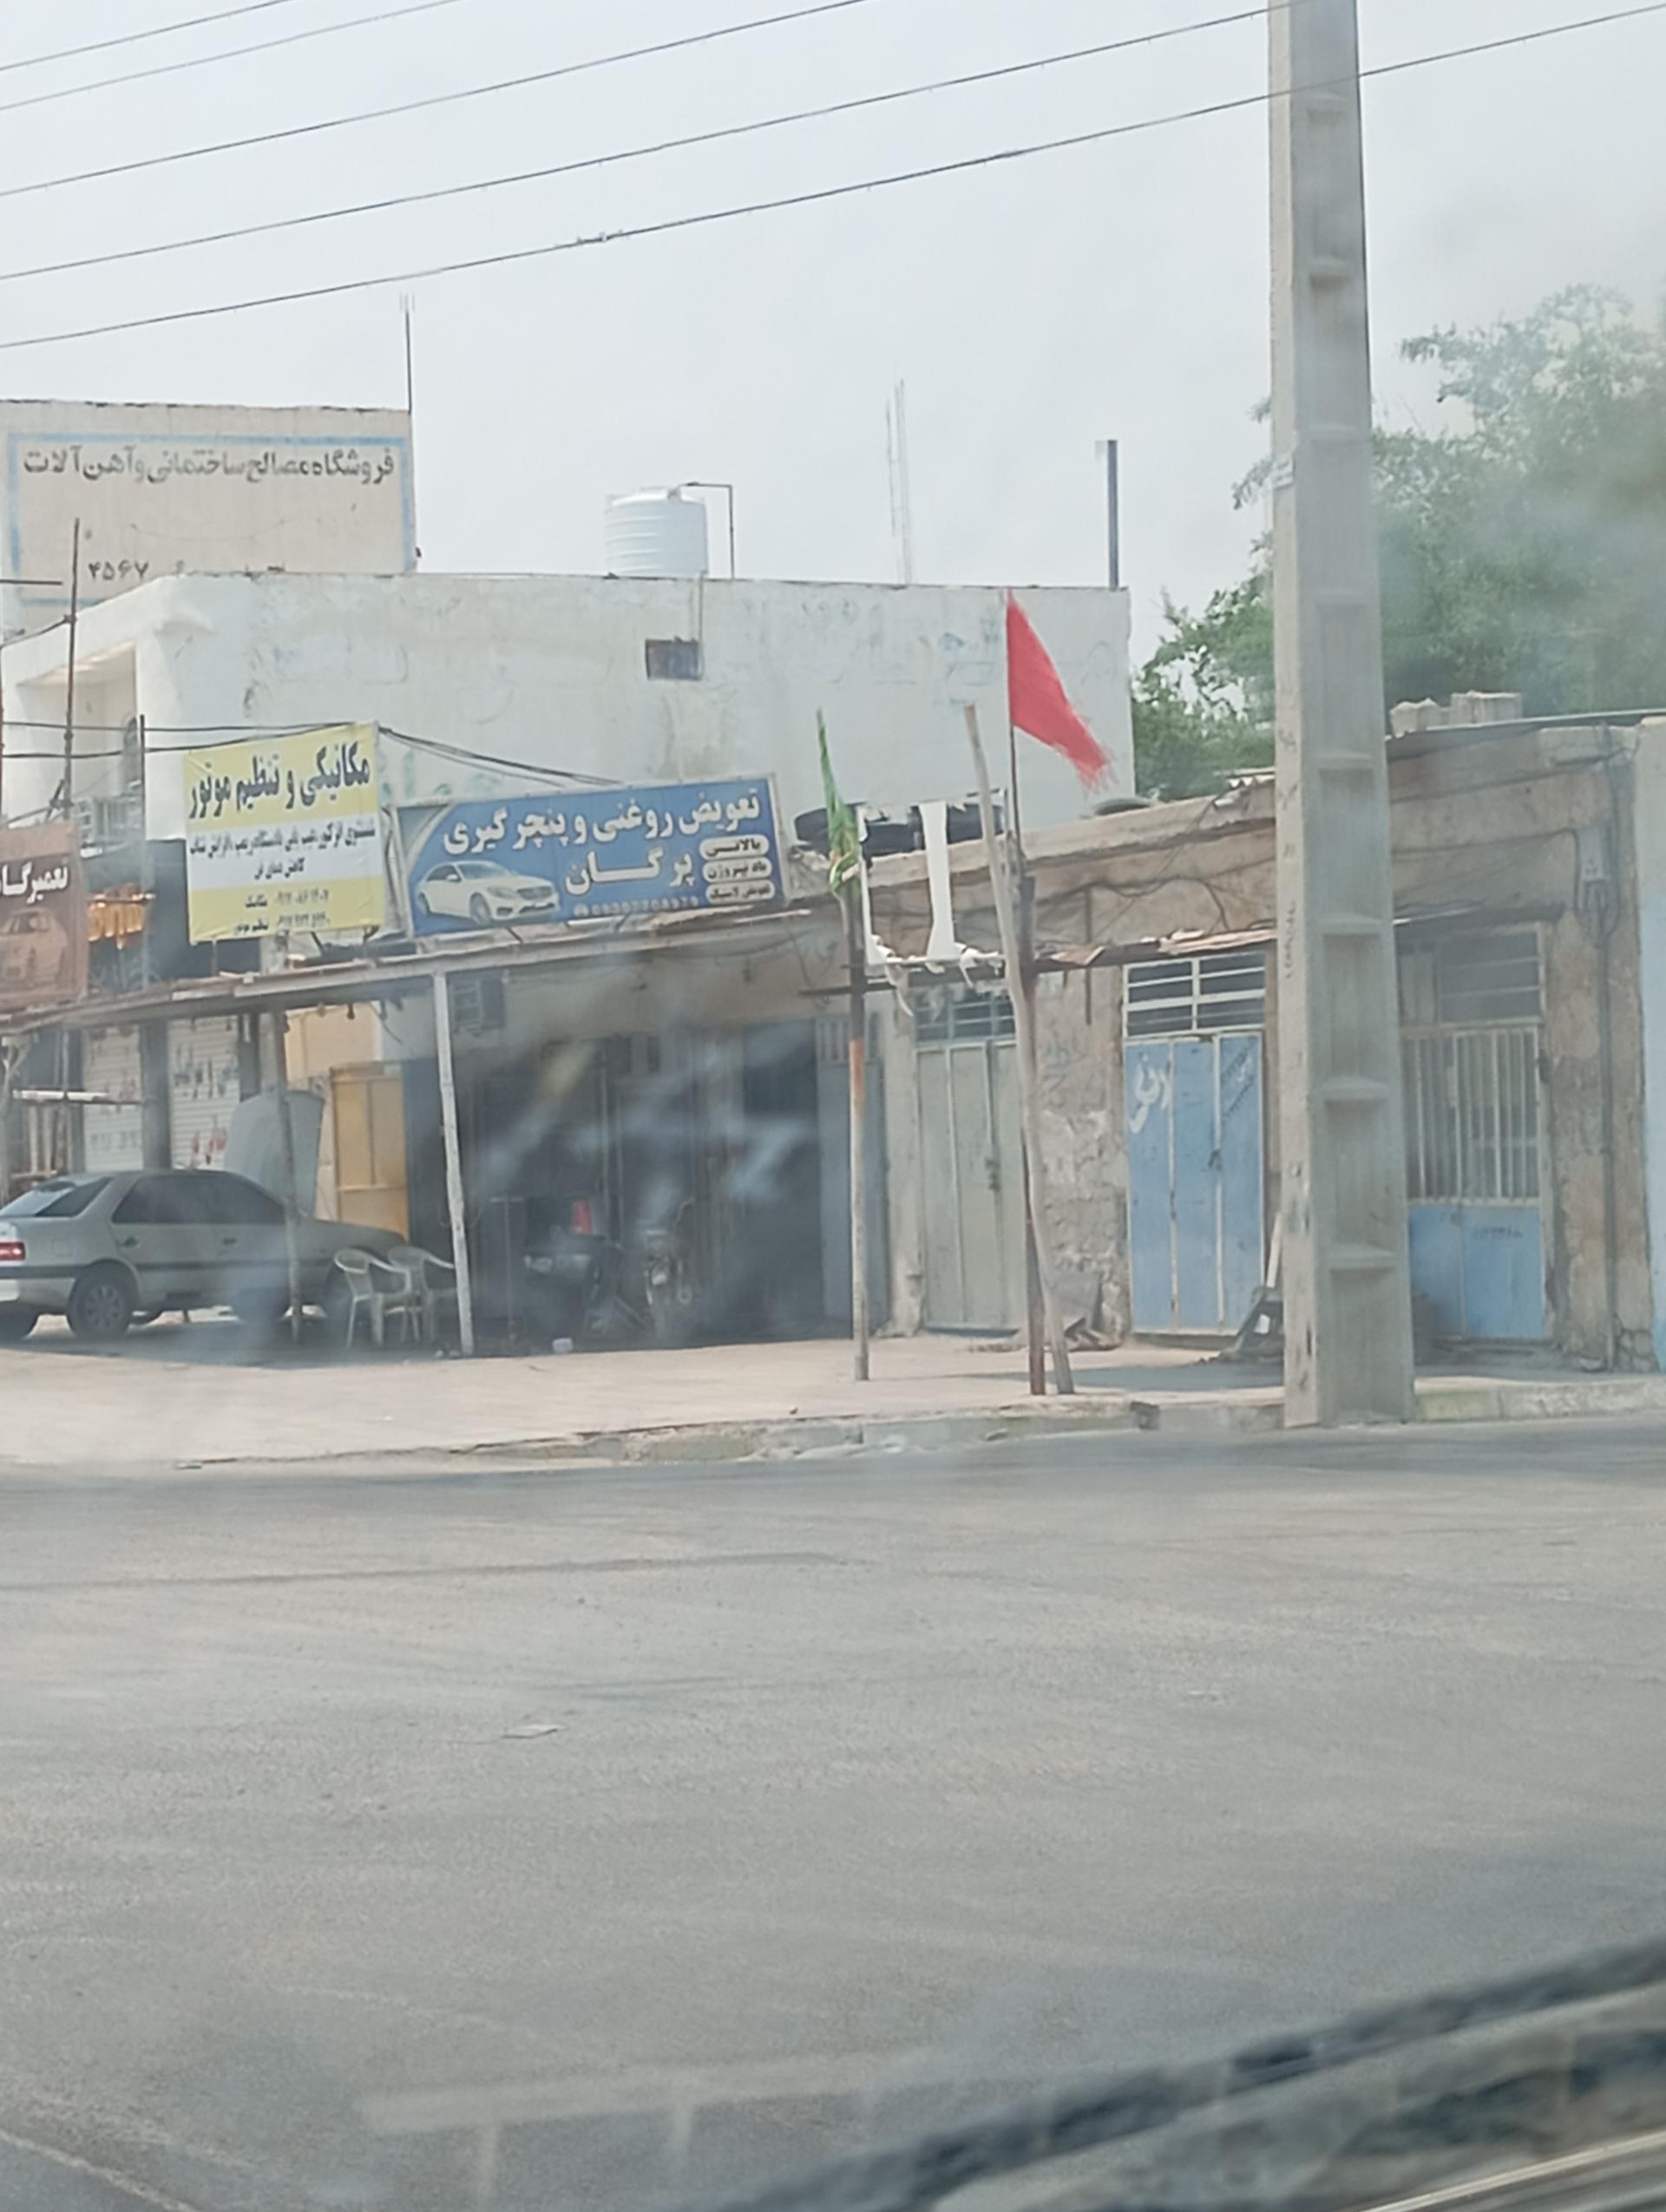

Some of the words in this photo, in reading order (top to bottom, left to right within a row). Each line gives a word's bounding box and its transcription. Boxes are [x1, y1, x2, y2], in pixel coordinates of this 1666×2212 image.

[23, 444, 82, 474] آلات
[83, 444, 137, 481] آهن
[148, 448, 245, 483] ساختمانی
[246, 450, 310, 483] مصالح
[312, 448, 395, 485] فروشگاه
[188, 762, 232, 820] موتور
[235, 752, 281, 813] تنظیم
[285, 769, 296, 810] و
[299, 741, 371, 808] مکانیکی
[573, 814, 587, 843] و
[592, 798, 674, 842] روغنی
[679, 787, 761, 836] تعویض
[0, 859, 69, 904] تعمیرگا
